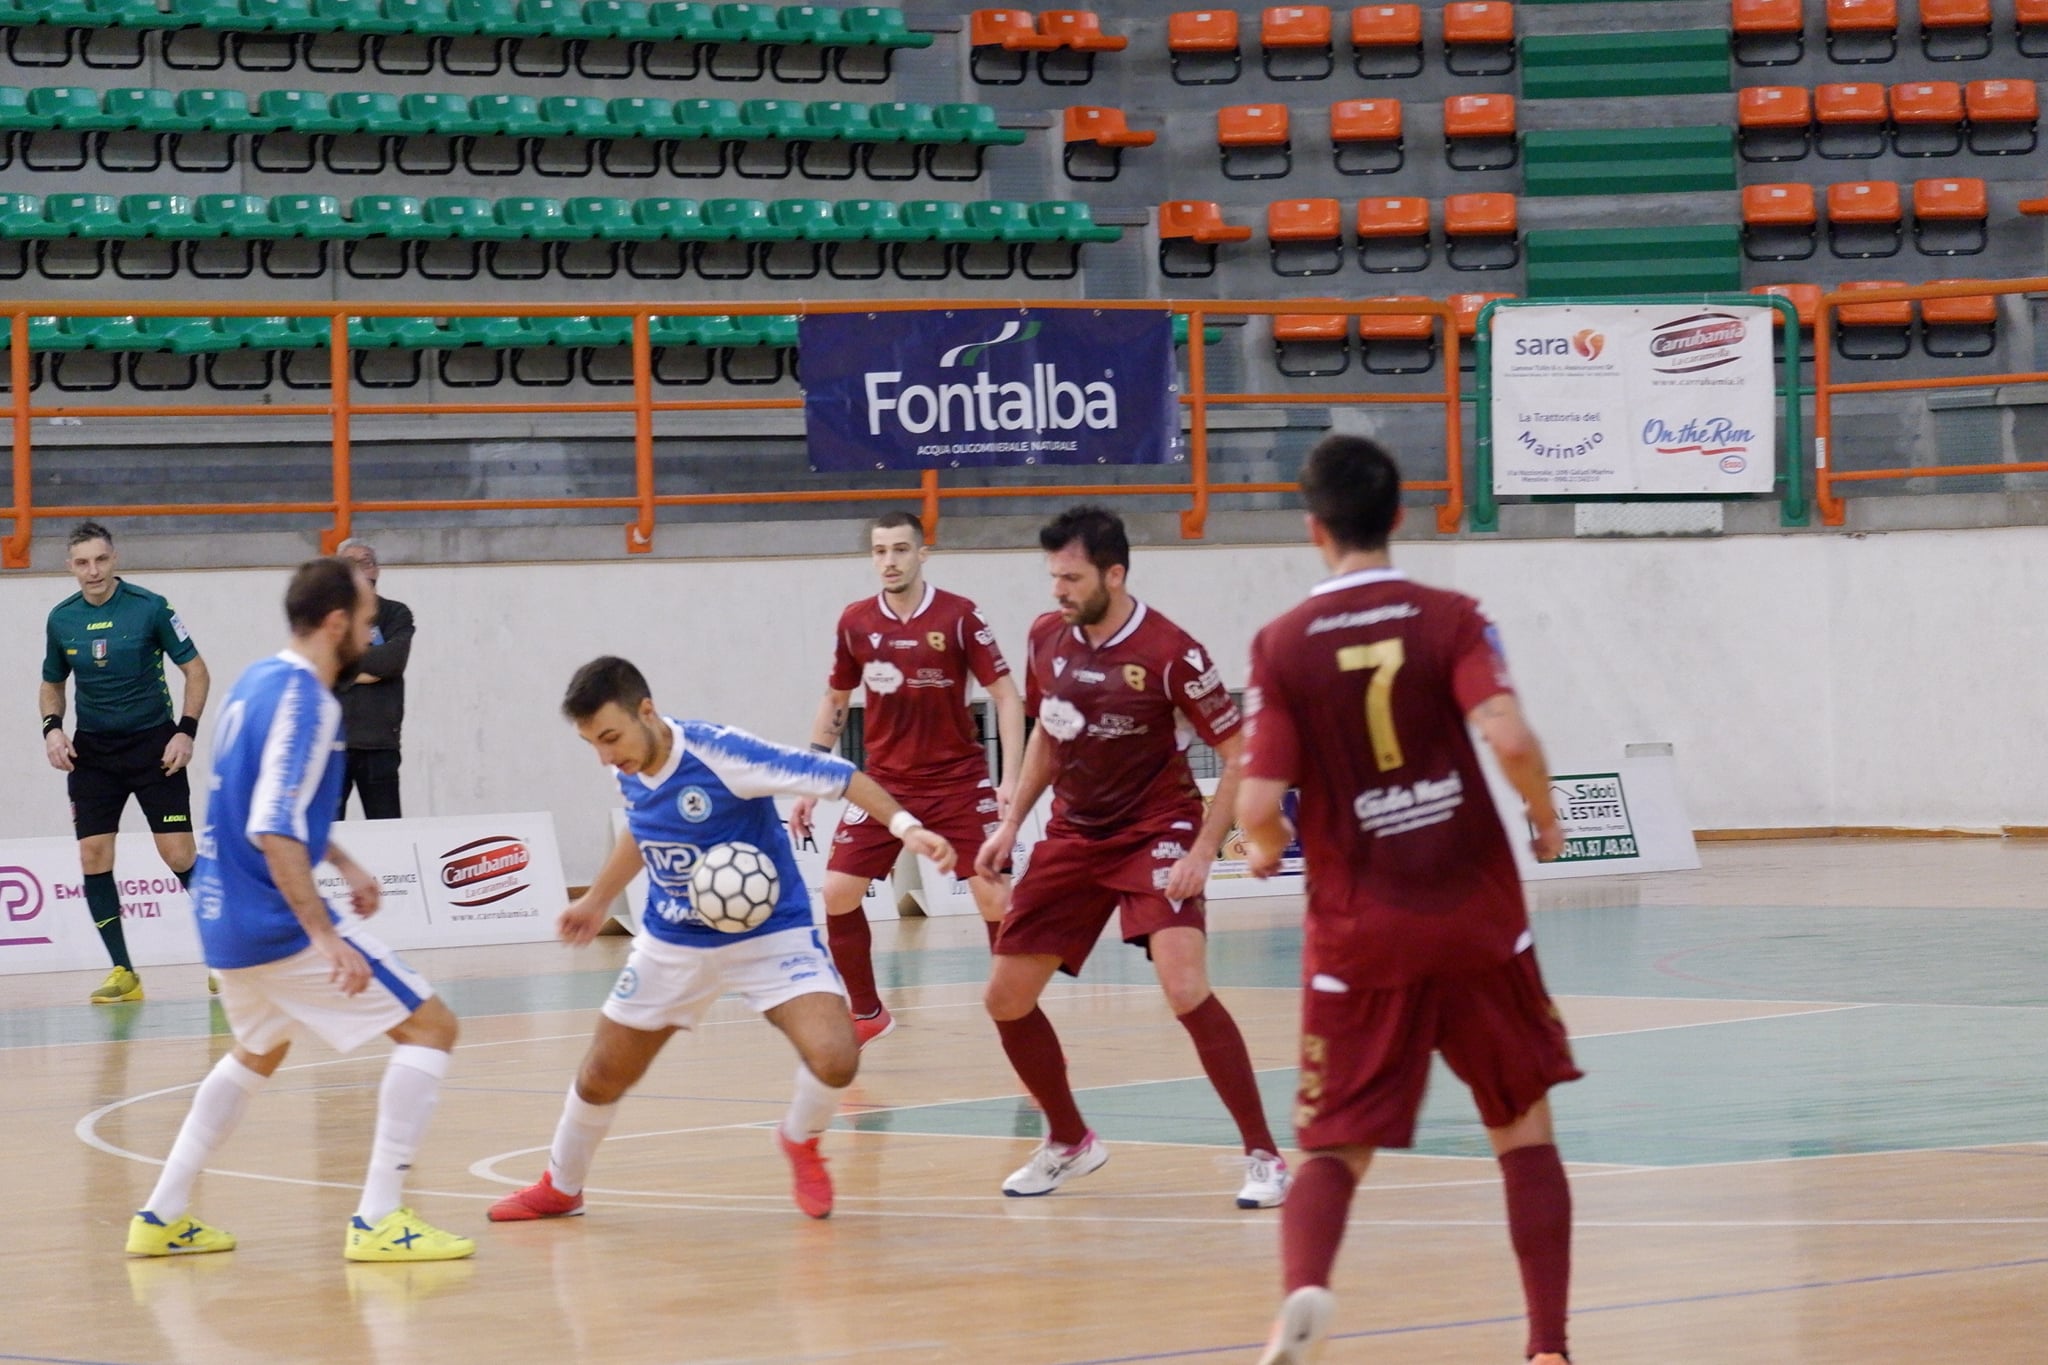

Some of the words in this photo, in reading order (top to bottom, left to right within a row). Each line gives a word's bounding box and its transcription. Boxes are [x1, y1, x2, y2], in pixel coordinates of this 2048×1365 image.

[1515, 338, 1569, 355] sara
[1652, 324, 1745, 352] Carrubamia
[1652, 377, 1745, 386] www.carrubamia.it
[864, 363, 1118, 435] Fontalba
[1519, 413, 1531, 422] La
[1533, 412, 1580, 422] Trattoria
[1582, 412, 1600, 421] del
[1643, 418, 1677, 445] On
[1678, 418, 1711, 443] the
[1706, 417, 1755, 446] Run
[917, 445, 949, 456] ACQUA
[951, 441, 1029, 454] OLIGOMINERALE
[1031, 440, 1078, 451] NATURALE
[1518, 430, 1603, 459] Marinaio
[1336, 637, 1405, 772] 7
[1575, 783, 1617, 799] Sidoti
[1571, 805, 1622, 820] ESTATE
[443, 848, 529, 885] Carrubamia
[382, 874, 416, 884] SERVICE
[117, 902, 161, 919] RVIZI
[451, 909, 539, 922] www.carrubamia.it
